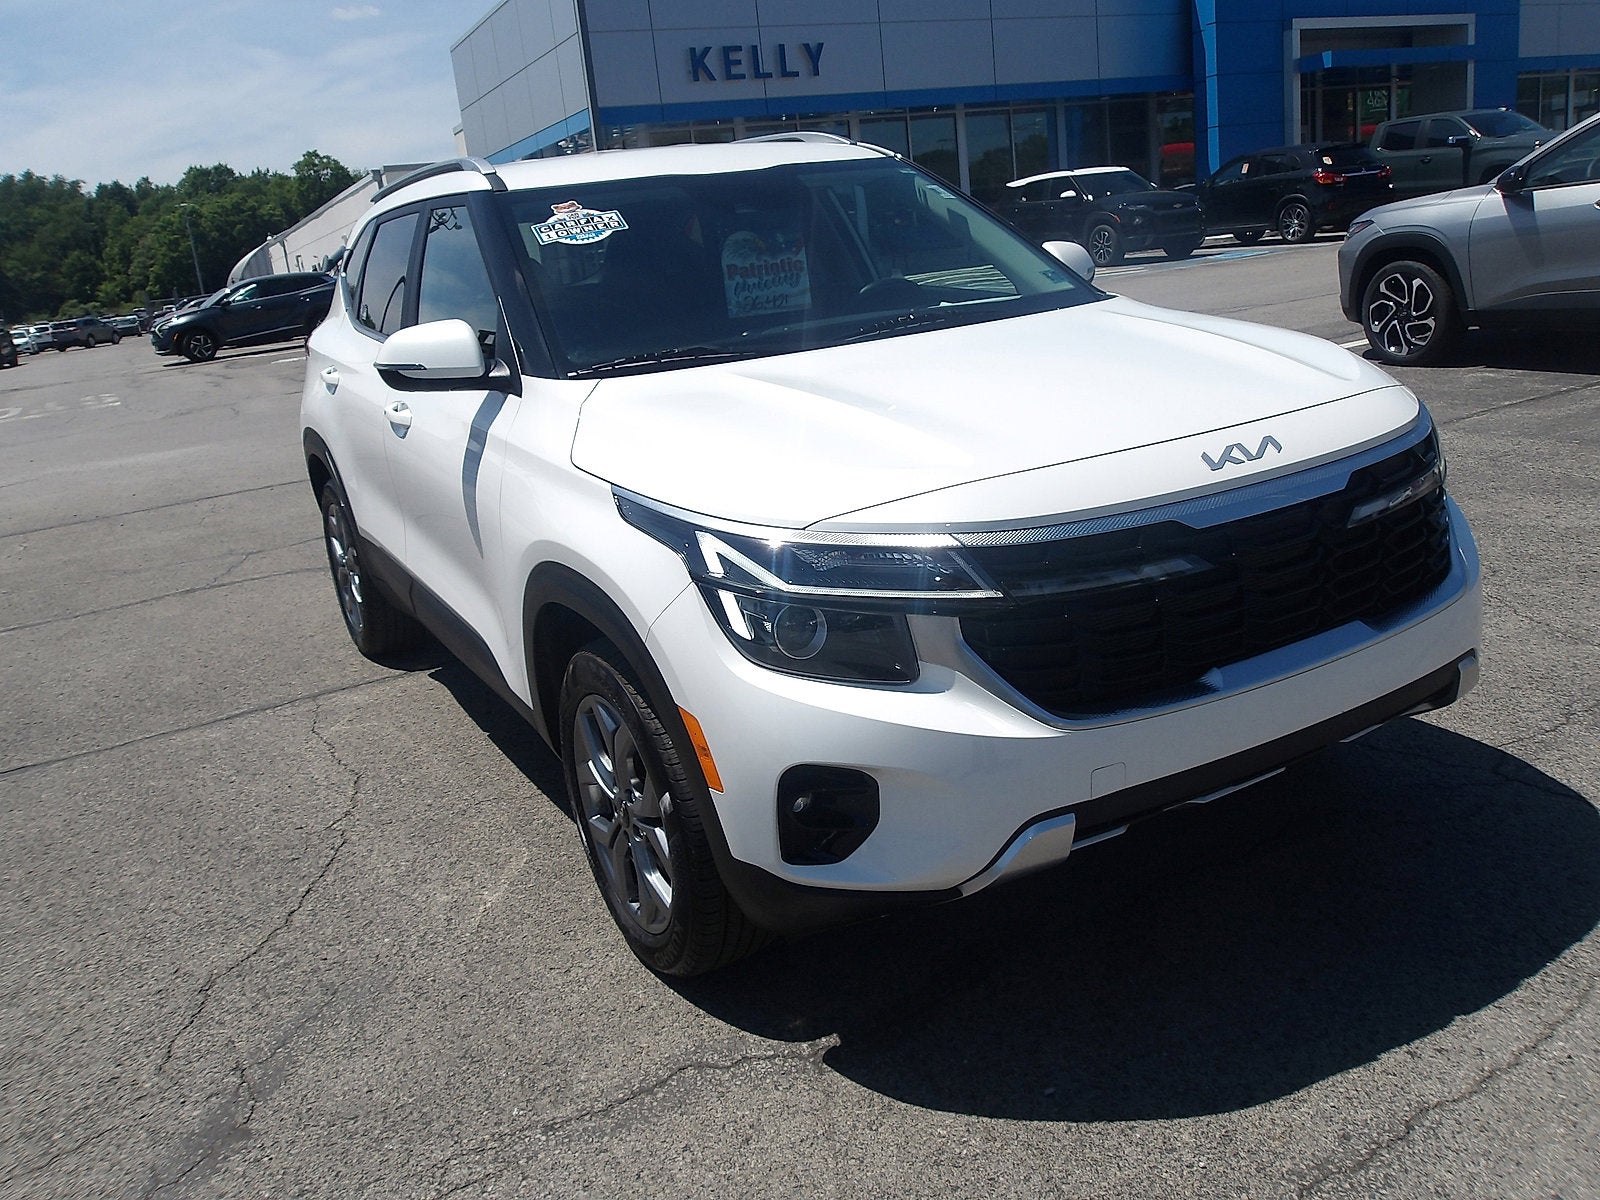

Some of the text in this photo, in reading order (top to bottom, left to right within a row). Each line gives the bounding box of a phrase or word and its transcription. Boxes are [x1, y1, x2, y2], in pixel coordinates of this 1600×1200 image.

[689, 42, 825, 81] KELLY
[539, 215, 615, 233] CARFAX
[557, 221, 620, 237] OWNER
[726, 257, 805, 281] Patriotic
[1201, 435, 1282, 471] KIA
